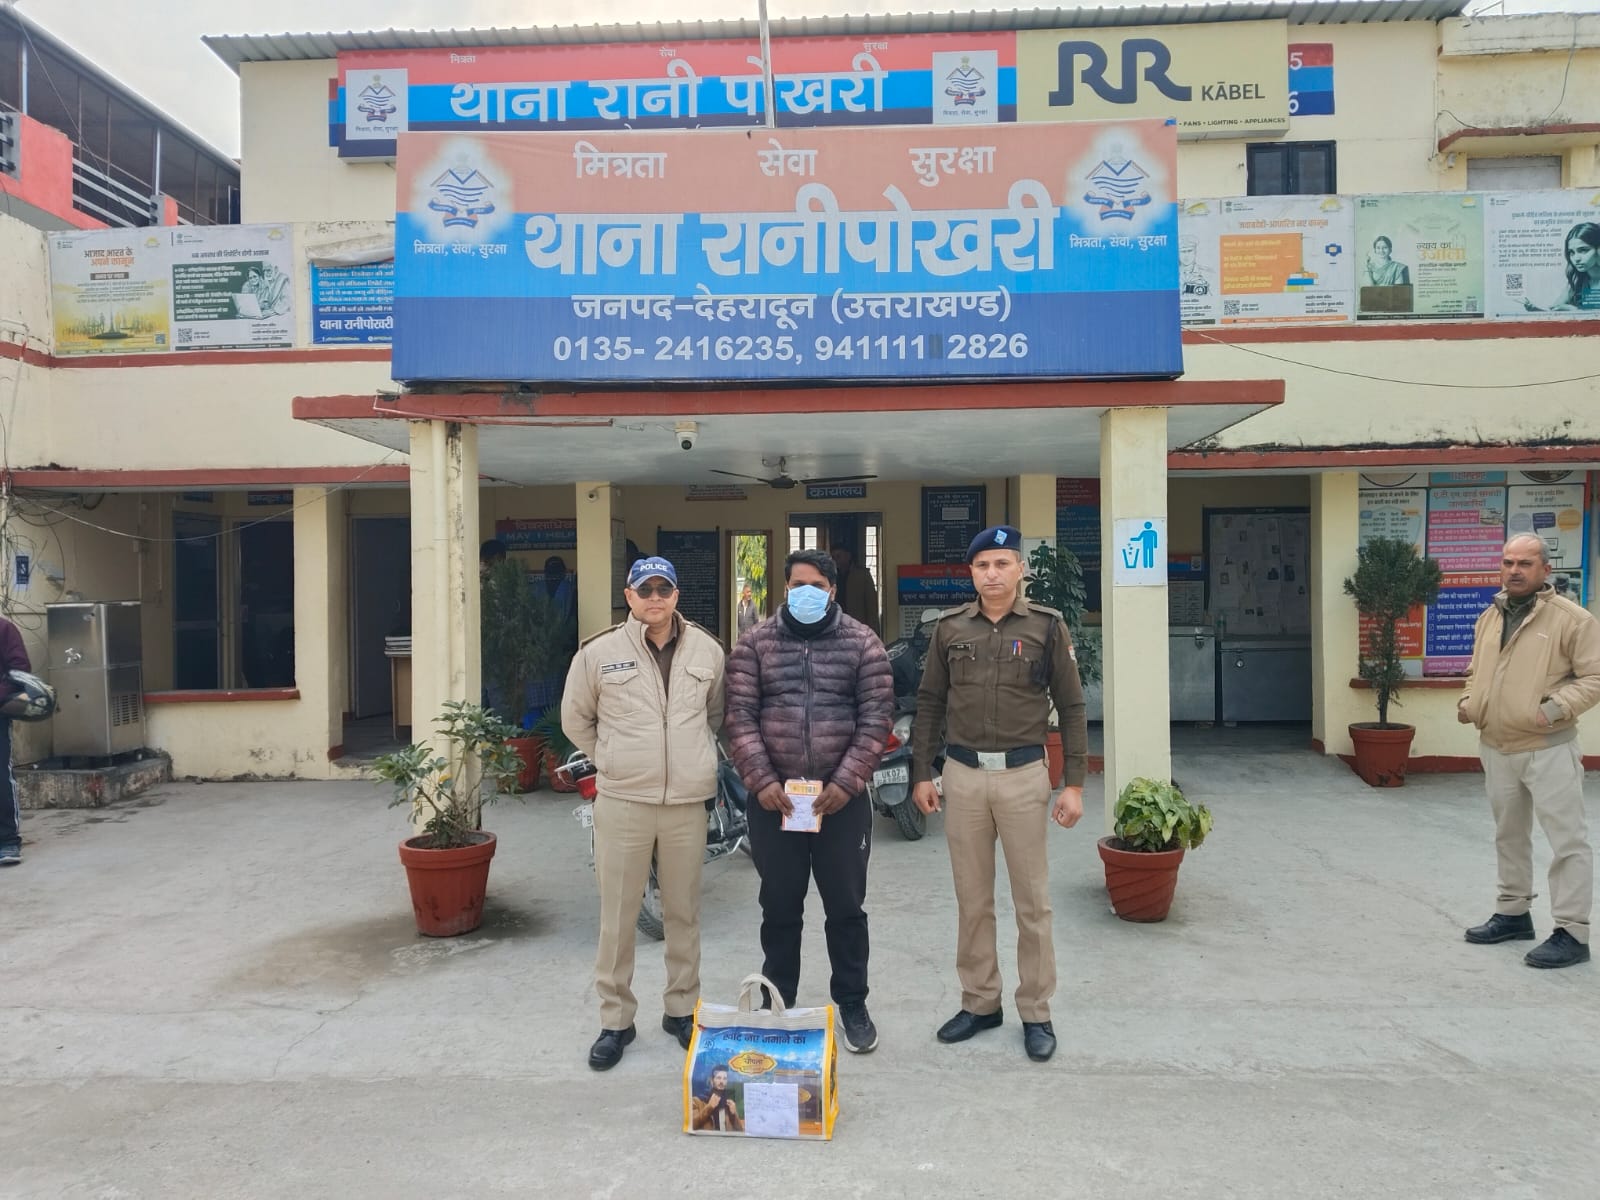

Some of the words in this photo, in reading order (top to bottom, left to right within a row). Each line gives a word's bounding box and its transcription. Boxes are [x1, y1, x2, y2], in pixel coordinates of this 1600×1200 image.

[1049, 38, 1192, 106] RR
[450, 80, 570, 124] थाना
[589, 58, 702, 121] रानी
[720, 53, 889, 118] पोखरी
[1244, 117, 1286, 125] APPLIANCES
[573, 139, 667, 179] मित्रता
[758, 138, 817, 178] सेवा
[909, 144, 996, 187] सुरक्षा
[525, 212, 684, 276] थाना
[701, 179, 1061, 278] रानीपोखरी
[478, 242, 507, 258] सुरक्षा
[1137, 234, 1167, 251] सुरक्षा
[831, 286, 1012, 324] (उत्तराखण्ड)
[320, 319, 341, 330] थाना
[344, 315, 394, 330] रानीपोखरी
[553, 336, 645, 362] 0135-
[655, 335, 802, 366] 2416235,
[947, 333, 1028, 360] 2826
[809, 483, 863, 498] कार्यालय
[640, 562, 668, 572] POLICE
